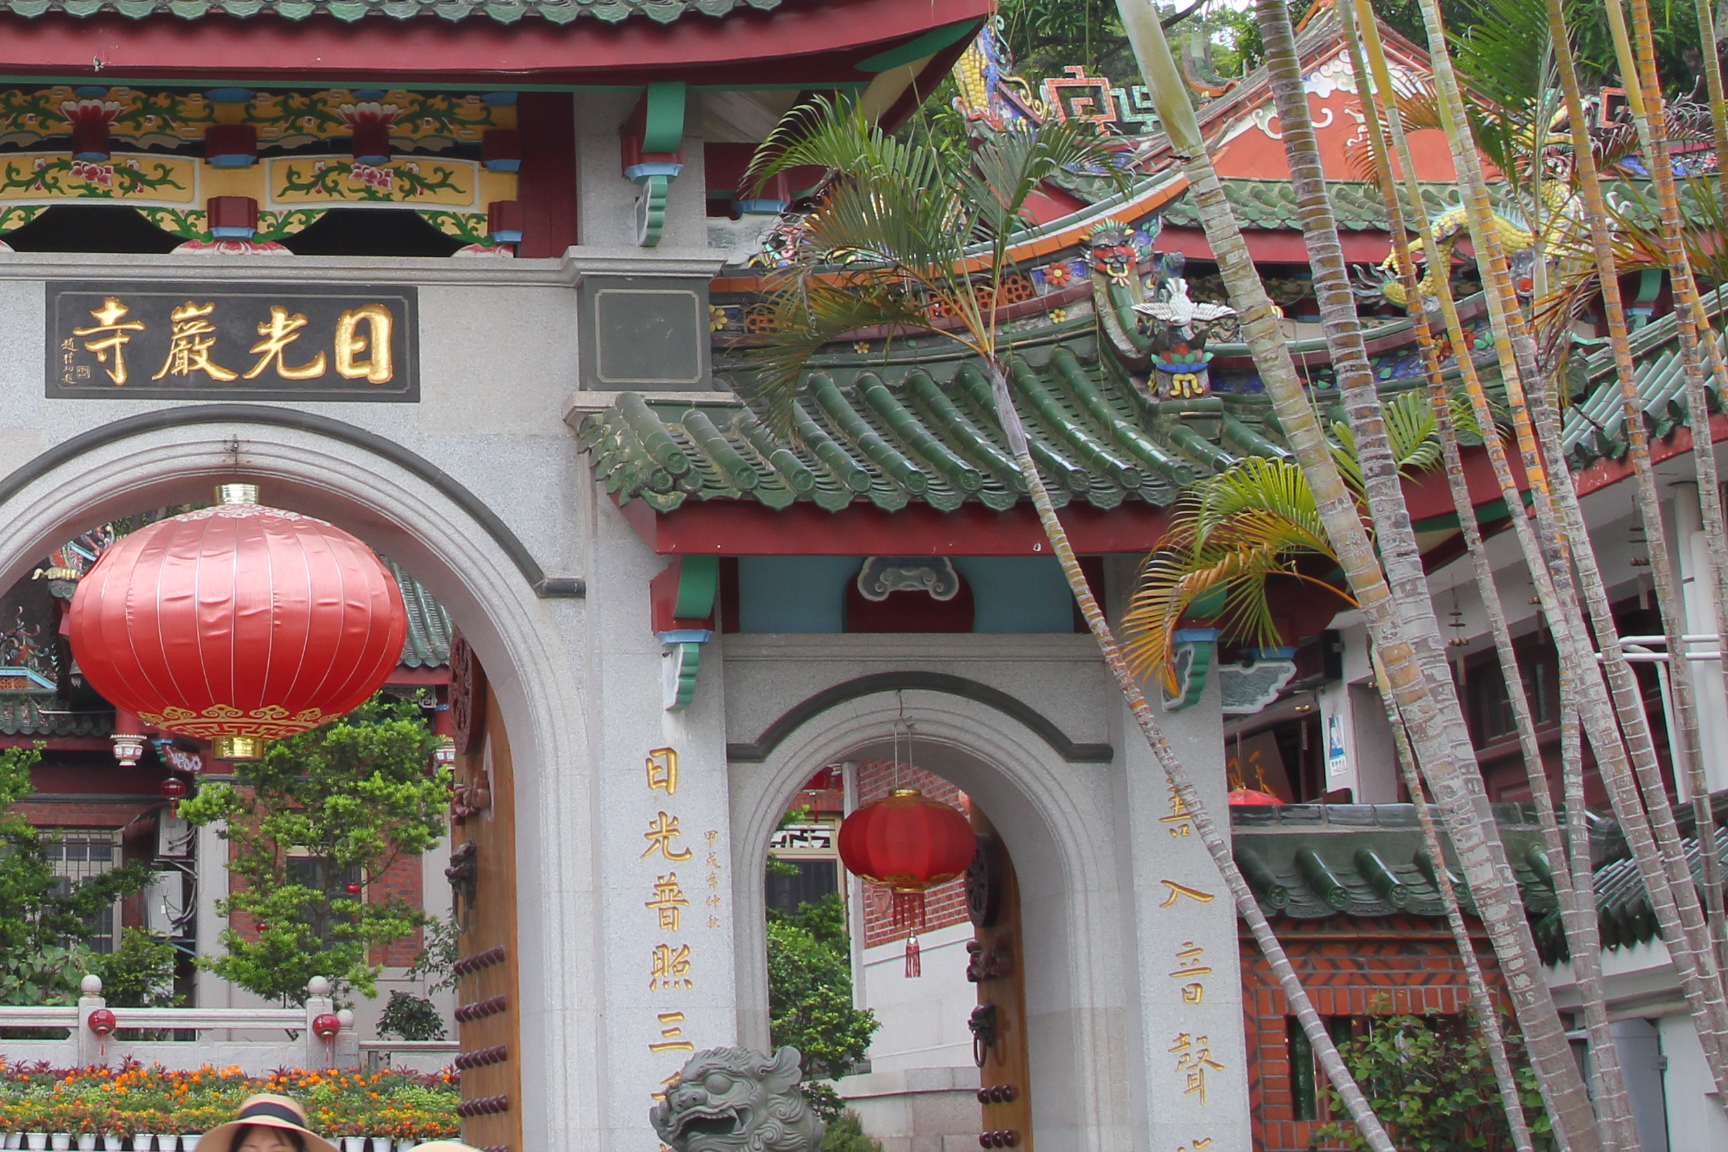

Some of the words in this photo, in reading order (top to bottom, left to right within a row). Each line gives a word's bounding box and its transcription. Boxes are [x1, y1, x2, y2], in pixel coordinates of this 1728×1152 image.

[640, 746, 694, 1152] 日光普照三
